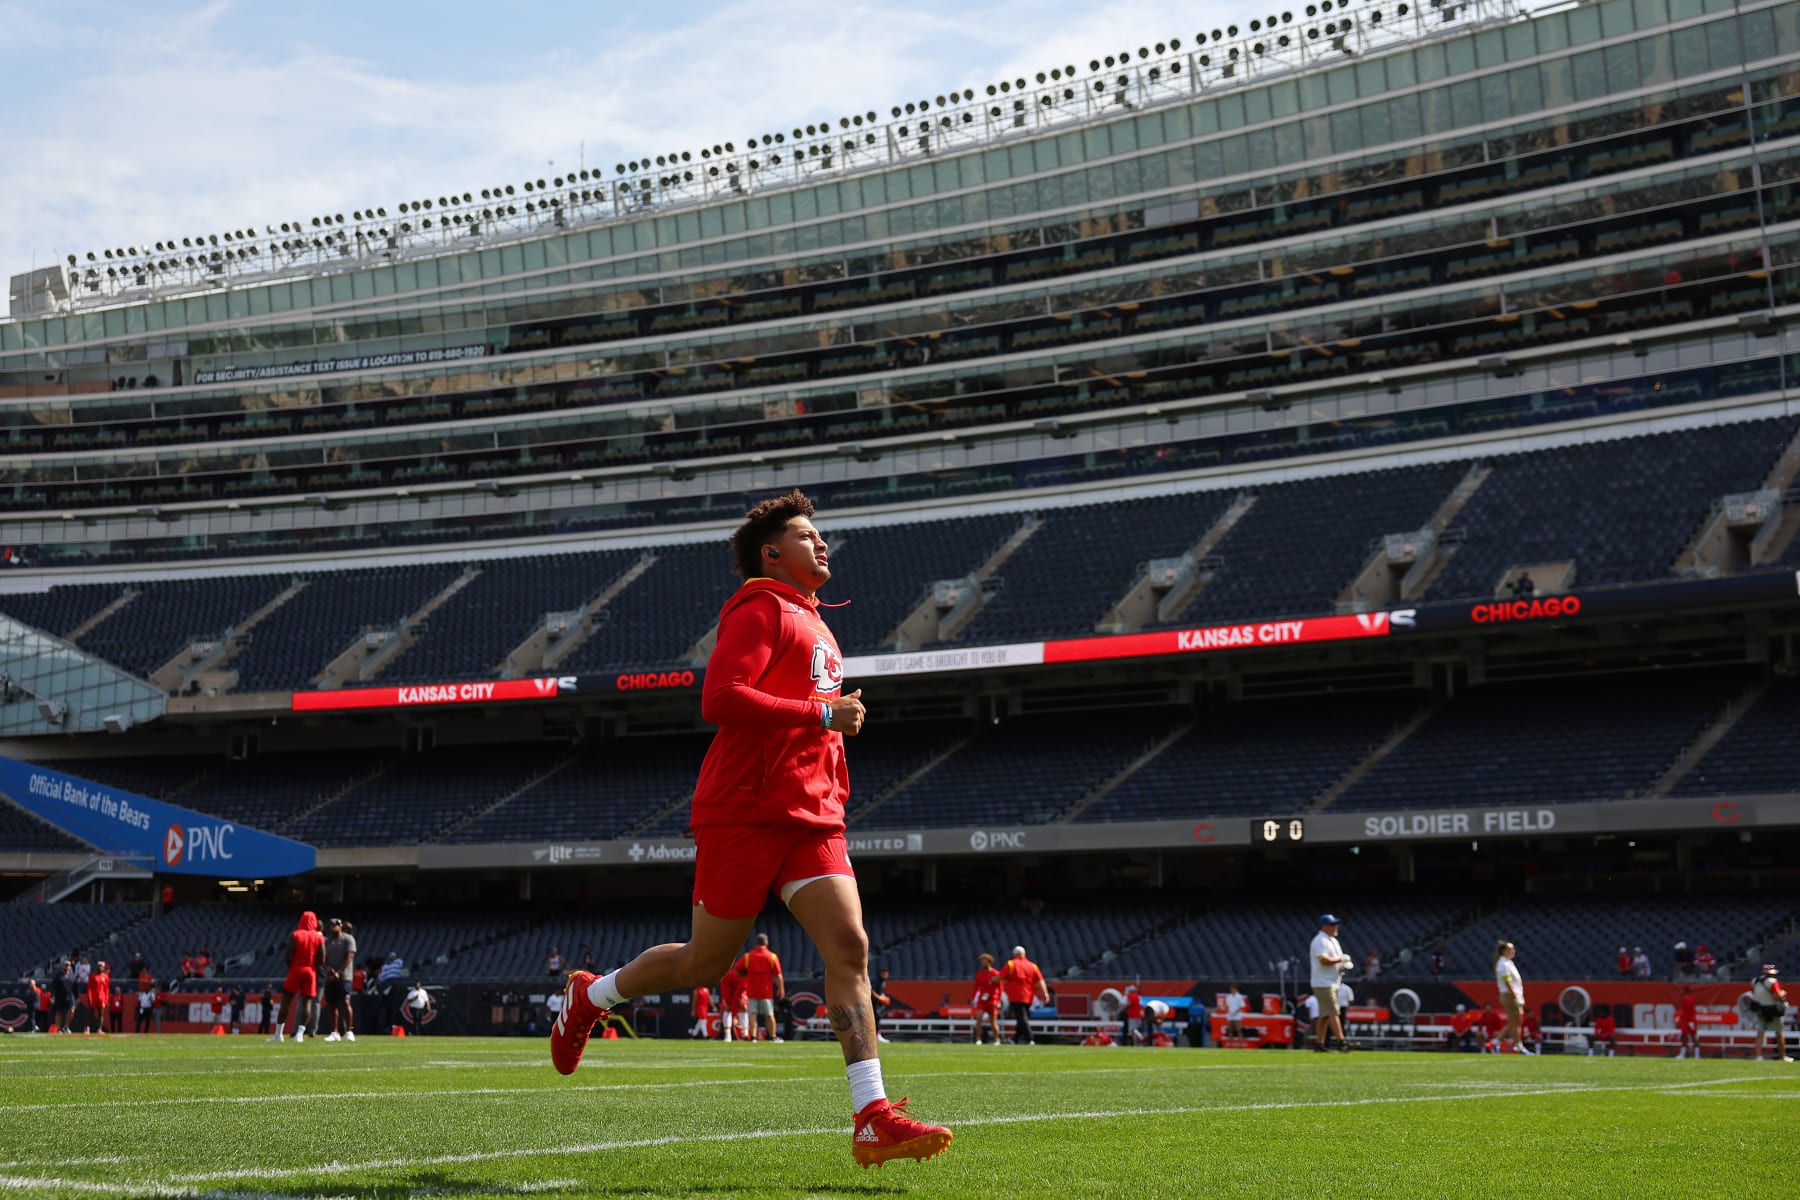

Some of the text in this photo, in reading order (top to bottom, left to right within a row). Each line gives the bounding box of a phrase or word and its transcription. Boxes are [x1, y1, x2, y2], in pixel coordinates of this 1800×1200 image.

[196, 372, 214, 383] FOR
[313, 361, 335, 372] TEXT
[336, 359, 360, 370] ISSUE
[370, 352, 413, 367] LOCATION
[415, 351, 428, 362] TO
[1471, 595, 1581, 624] CHICAGO
[1178, 621, 1303, 649] KANSAS CITY
[398, 683, 494, 703] KANSAS CITY
[616, 670, 695, 690] CHICAGO
[29, 773, 151, 830] Official Bank of the Bears
[1365, 810, 1556, 837] SOLDIER FIELD
[187, 824, 234, 861] PNC
[990, 832, 1026, 848] PNC
[550, 846, 573, 863] Lite
[856, 1134, 879, 1142] adidas
